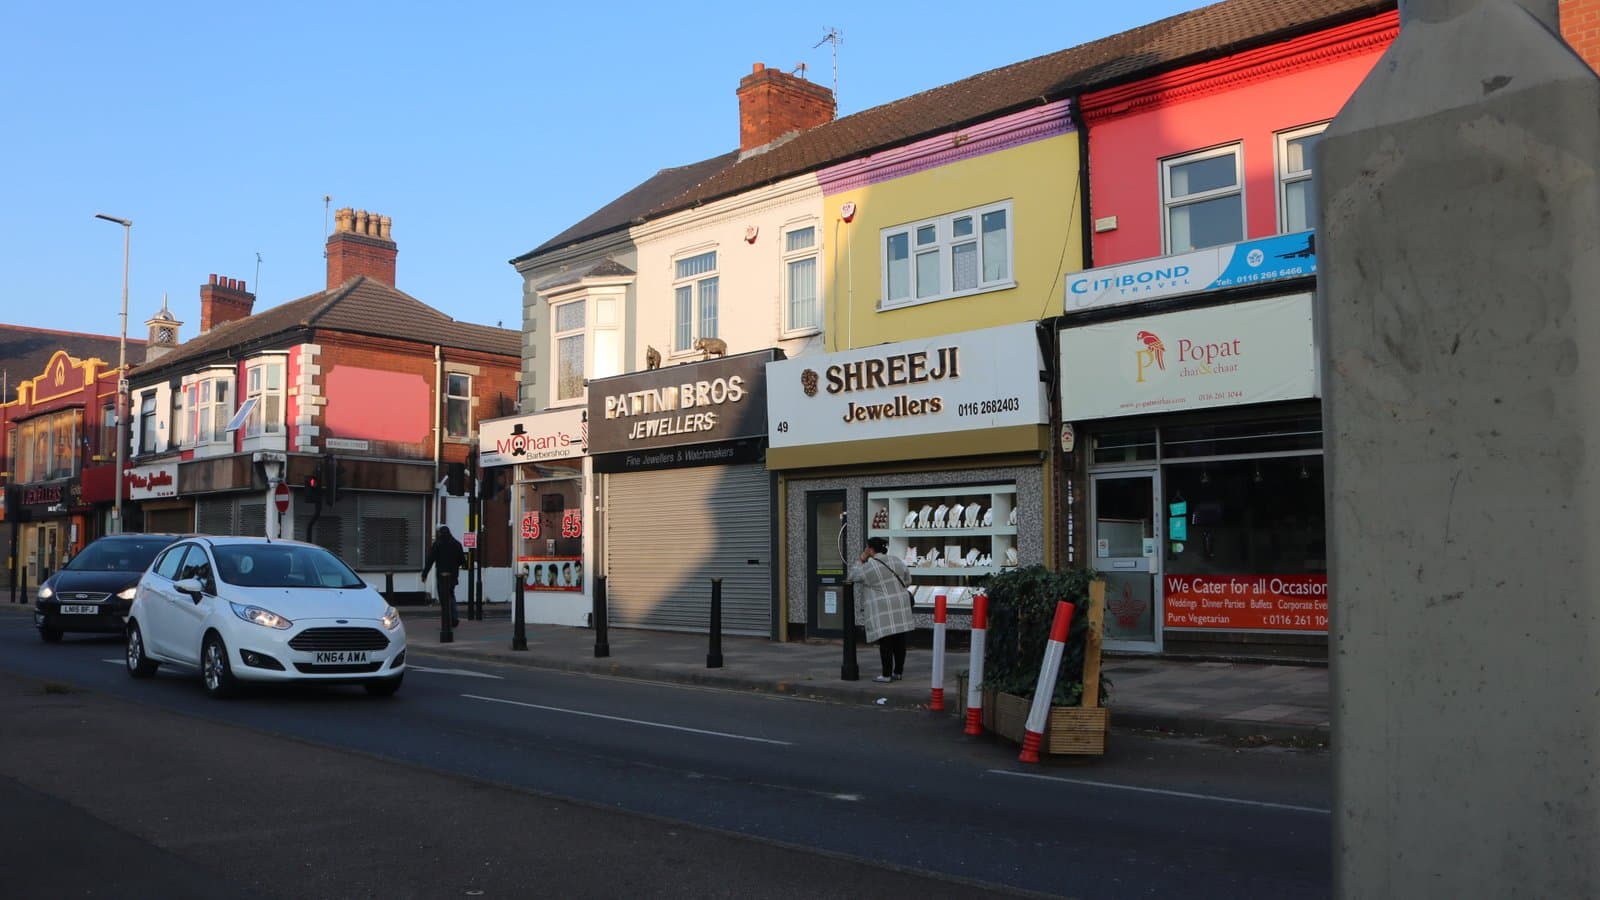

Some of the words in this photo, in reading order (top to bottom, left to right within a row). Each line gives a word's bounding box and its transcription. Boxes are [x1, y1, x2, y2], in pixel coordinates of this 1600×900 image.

[1120, 279, 1190, 296] TRAVEL
[1236, 273, 1259, 284] 0116
[1177, 337, 1241, 365] Popat
[825, 347, 960, 395] SHREEJI
[605, 386, 679, 420] PATTNI
[680, 375, 745, 409] BROS
[958, 402, 979, 417] 0116
[981, 397, 1020, 415] 2682403
[842, 394, 943, 424] Jewellers
[628, 411, 716, 441] JEWELLERS
[777, 421, 789, 434] 49
[526, 448, 571, 461] Barbershop
[624, 455, 641, 468] Fine
[642, 452, 675, 466] Jewellers
[677, 450, 683, 461] &
[685, 447, 735, 462] Watchmakers
[521, 517, 541, 539] £5
[562, 515, 582, 538] £5
[1168, 577, 1190, 594] We
[1192, 577, 1227, 595] Cater
[1230, 577, 1249, 595] for
[1252, 577, 1266, 595] all
[1168, 597, 1198, 611] Weddings
[1201, 598, 1223, 609] Dinner
[1224, 598, 1246, 609] Parties
[1250, 599, 1273, 609] Buffets
[1277, 599, 1313, 612] Corporate
[1168, 612, 1187, 623] Pure
[1187, 613, 1230, 625] Vegetarian
[1269, 615, 1292, 625] 0116
[1295, 615, 1312, 625] 261
[316, 651, 345, 663] KN64
[346, 651, 368, 663] AWA
